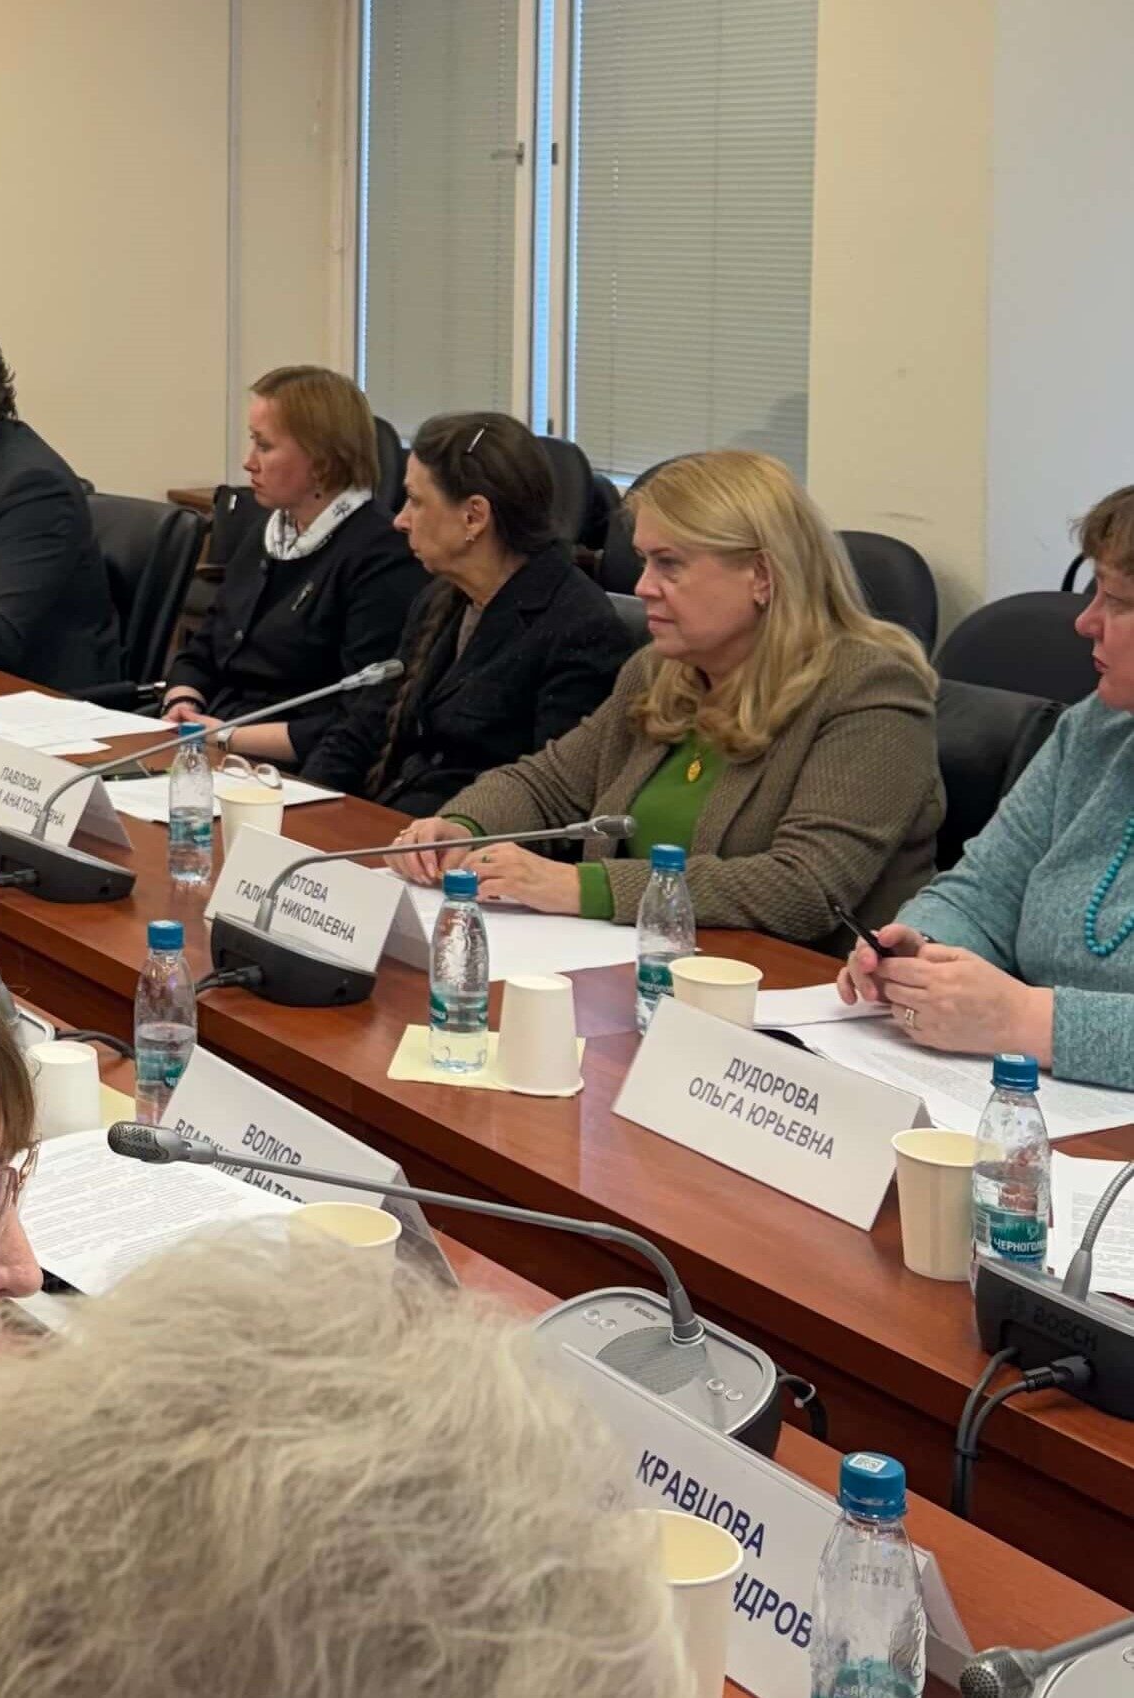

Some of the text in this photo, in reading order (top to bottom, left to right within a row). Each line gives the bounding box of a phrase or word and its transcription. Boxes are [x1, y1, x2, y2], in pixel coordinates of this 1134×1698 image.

[1, 766, 42, 794] ПАВЛОВА
[2, 792, 66, 827] АНАТОЛЬВНА
[236, 879, 356, 943] ГАЛИА НИКОЛАЕВНА
[723, 1056, 820, 1116] ДУДОРОВА
[688, 1076, 835, 1160] ОЛЬГА ЮРЬЕВНА
[636, 1449, 765, 1559] КРАВЦОВА
